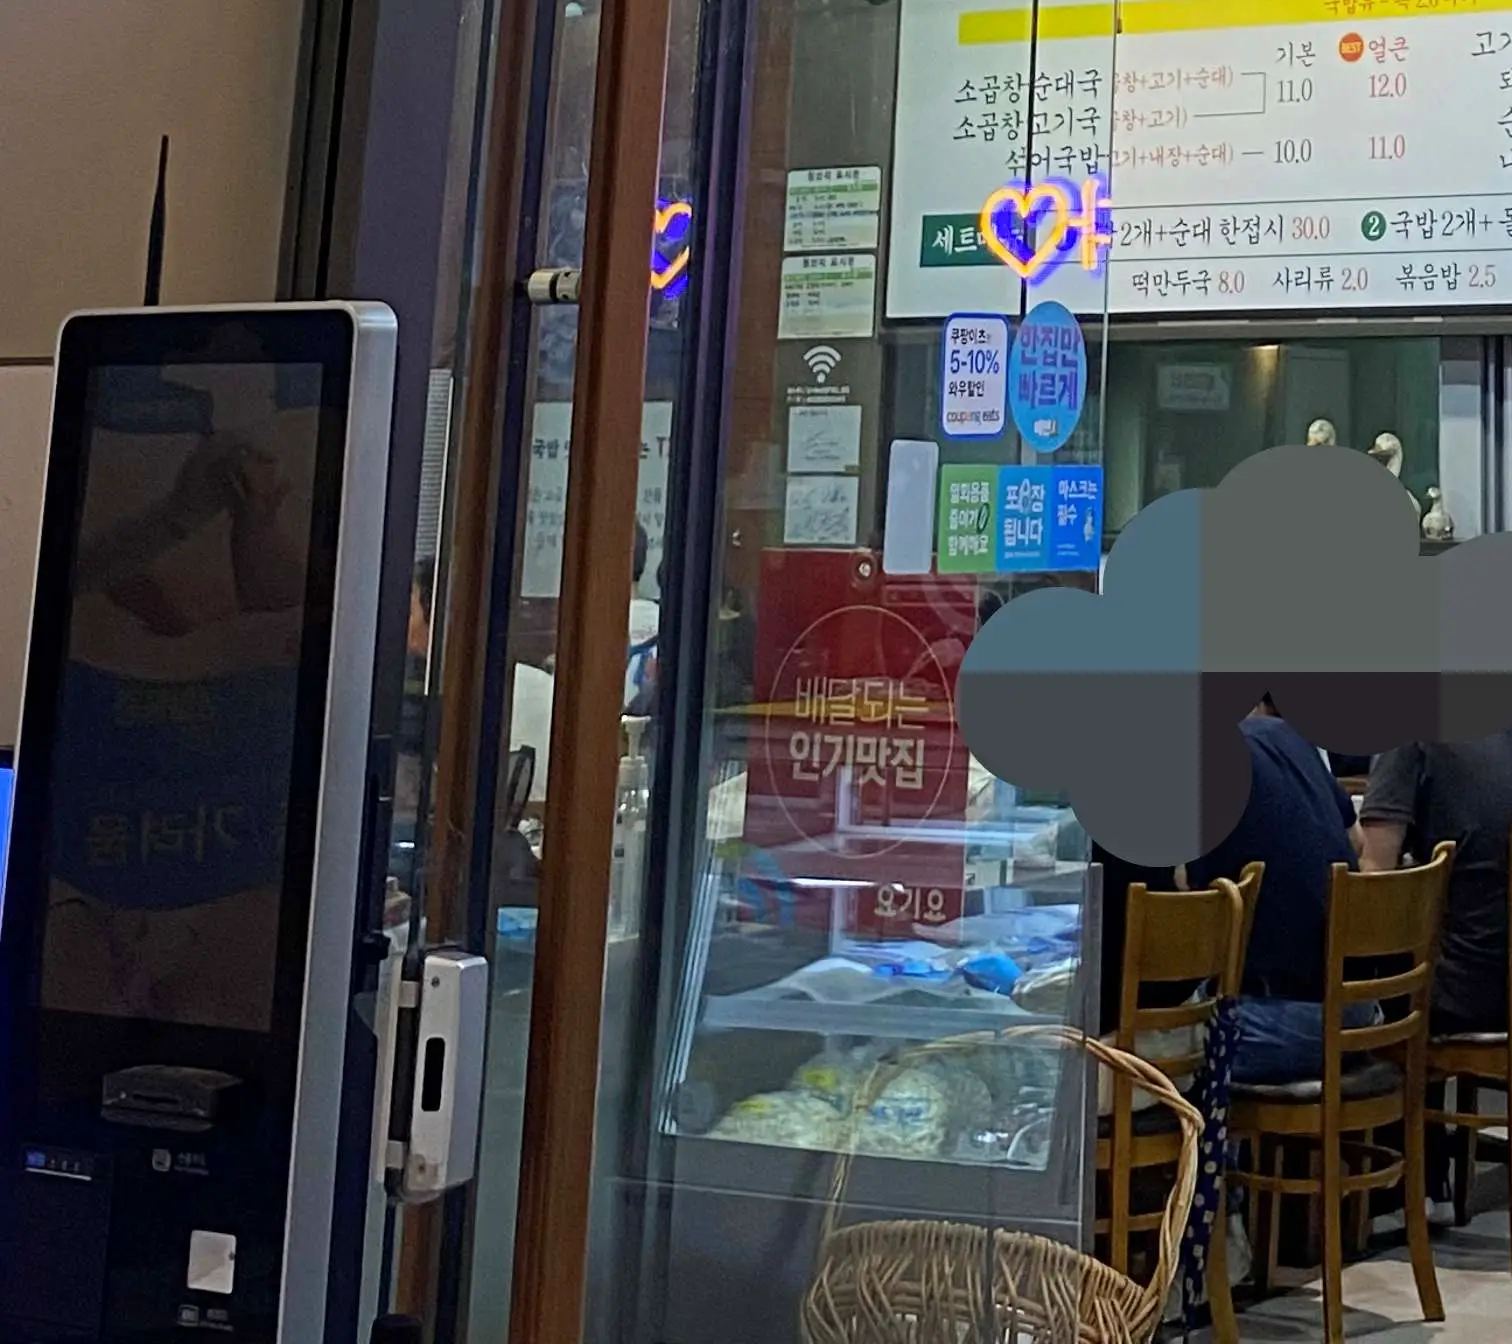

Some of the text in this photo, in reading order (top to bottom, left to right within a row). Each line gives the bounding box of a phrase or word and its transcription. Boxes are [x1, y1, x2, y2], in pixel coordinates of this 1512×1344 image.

[1275, 40, 1316, 68] 기본
[1368, 36, 1410, 63] 얼큰
[954, 72, 1028, 105] 소곱창
[1033, 69, 1102, 101] 순대국
[1277, 72, 1408, 103] 11.0 12.0
[952, 109, 1025, 142] 소곱창
[1032, 107, 1101, 139] 고기국
[1274, 134, 1407, 164] 10.0 11.0
[1292, 216, 1331, 240] 30.0
[1132, 269, 1245, 297] 떡만두국 8.0
[1272, 265, 1369, 296] 사리류 2.0
[1396, 263, 1497, 292] 볶음밥 2.5
[950, 349, 1000, 374] 5-10%
[1020, 324, 1081, 369] 한집만
[948, 379, 985, 397] 와우할인
[1018, 370, 1079, 410] 빠르게
[1058, 479, 1098, 501] 마스크는
[1056, 504, 1079, 527] 필수
[1003, 516, 1044, 547] 됩니다
[794, 676, 931, 731] 배달되는
[789, 730, 925, 789] 인기맛집
[874, 883, 947, 922] 요기요
